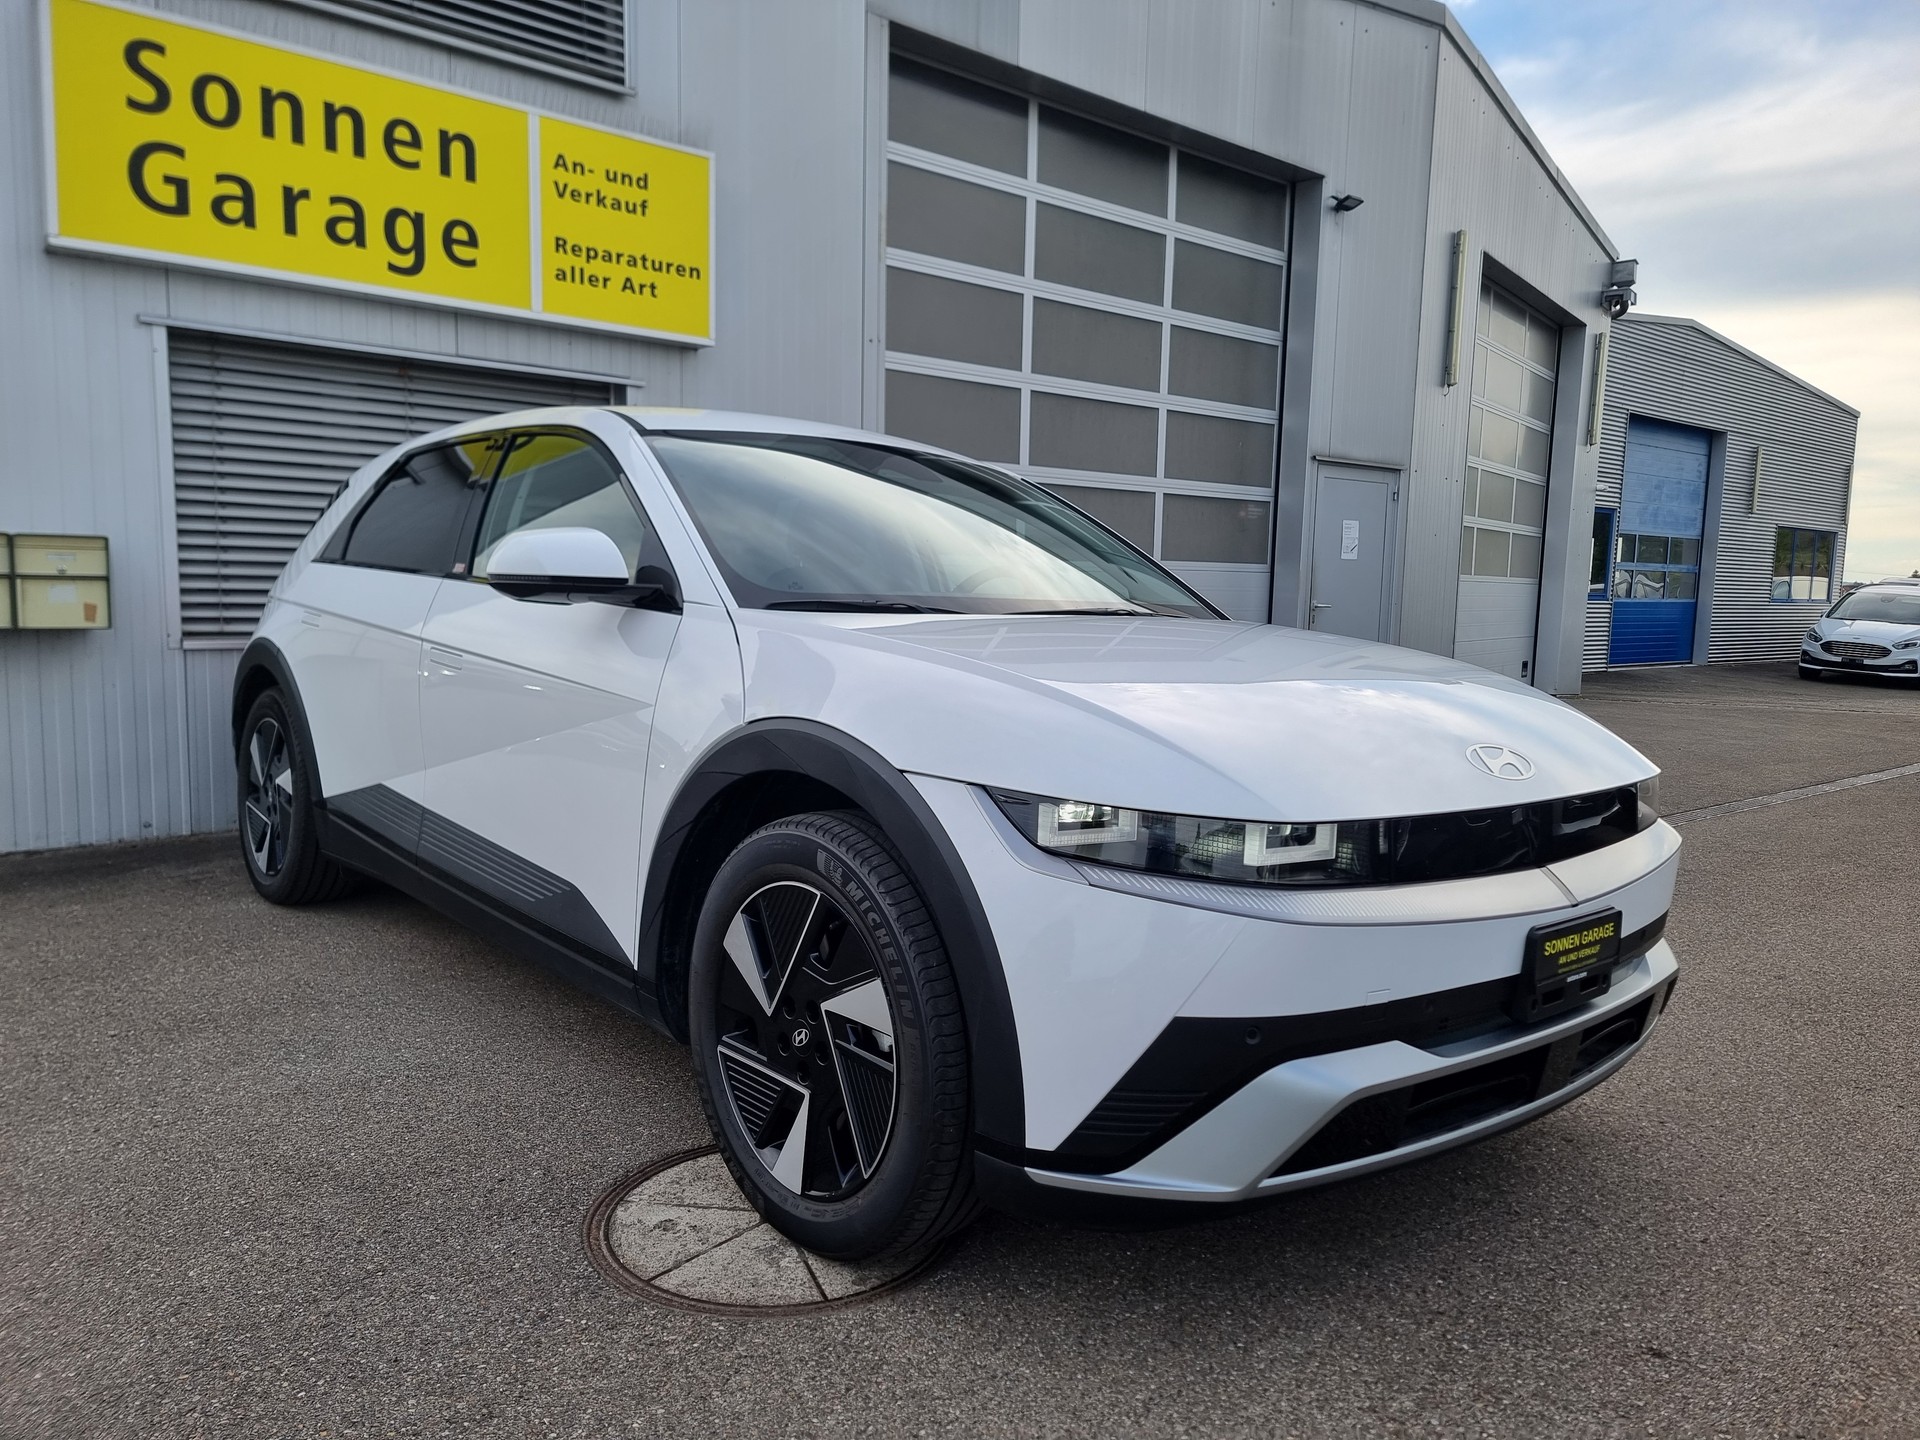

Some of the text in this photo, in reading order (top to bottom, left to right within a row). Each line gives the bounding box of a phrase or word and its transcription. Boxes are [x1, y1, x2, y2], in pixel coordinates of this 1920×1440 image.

[123, 38, 479, 183] Sonnen
[553, 153, 650, 191] An- und
[126, 141, 480, 277] Garage
[553, 180, 649, 217] Verkauf
[554, 236, 702, 280] Reparaturen
[555, 266, 658, 298] aller Art
[845, 880, 914, 1020] MICHELIN
[1544, 922, 1615, 956] SONNEN GARAGE
[1567, 951, 1579, 962] UND
[1578, 944, 1601, 958] VERKAUF
